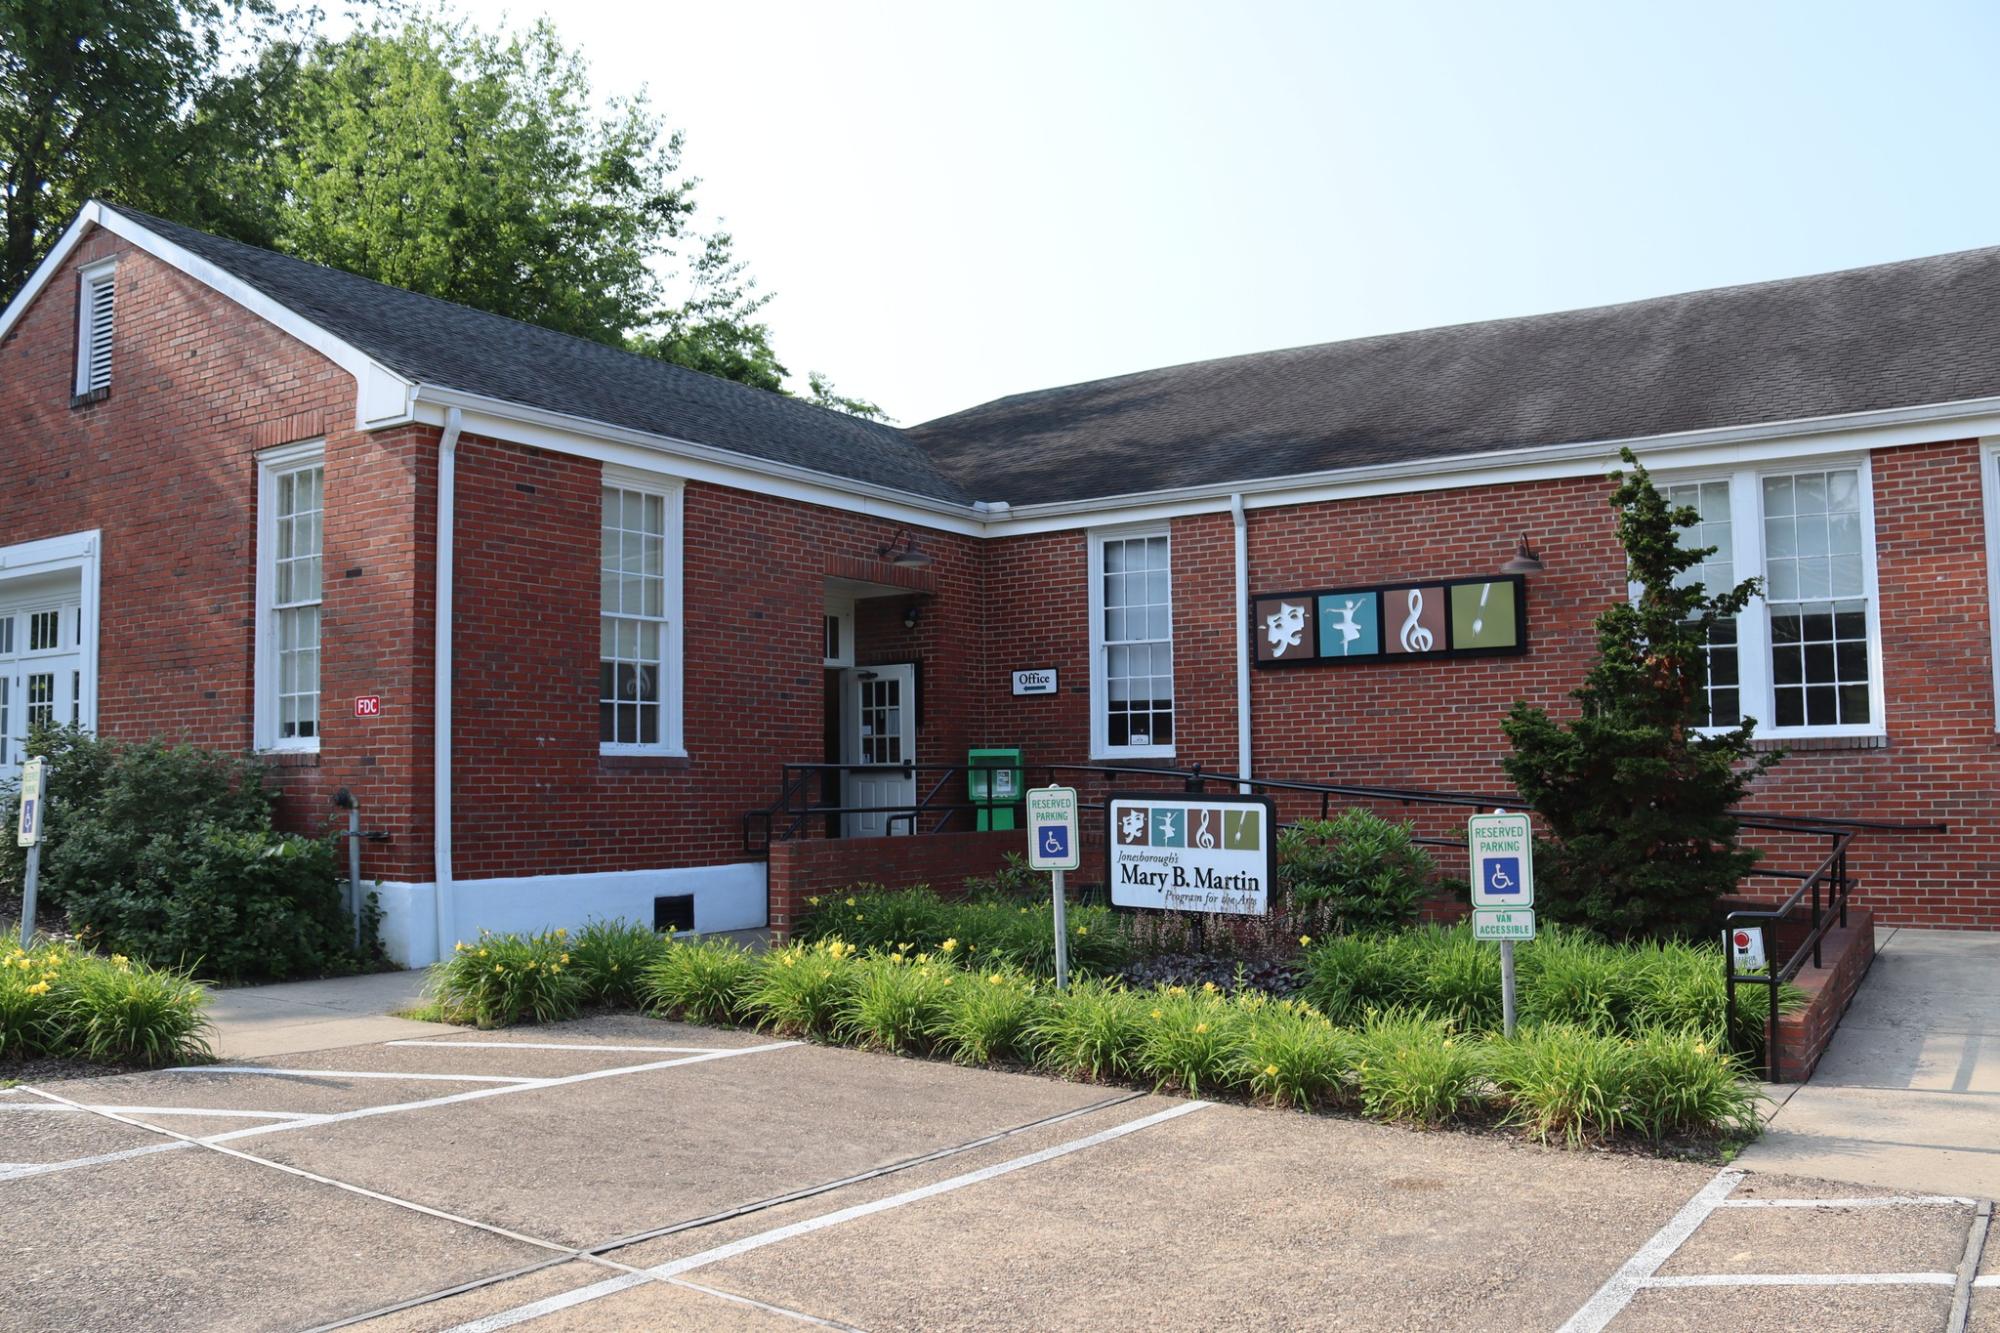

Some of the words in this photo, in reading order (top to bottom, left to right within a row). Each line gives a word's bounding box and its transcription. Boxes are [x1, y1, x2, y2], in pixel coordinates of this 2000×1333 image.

[1019, 672, 1050, 685] Office
[357, 698, 377, 714] FDC
[1031, 799, 1071, 809] RESERVED
[1036, 811, 1068, 821] PARKING
[1475, 826, 1524, 838] RESERVED
[1480, 841, 1520, 853] PARKING
[1117, 850, 1179, 867] Jonesborough's
[1120, 863, 1169, 892] Mary
[1172, 866, 1190, 888] B.
[1194, 867, 1260, 891] Martin
[1165, 889, 1202, 904] Program
[1203, 892, 1219, 906] for
[1496, 914, 1512, 923] VAN
[1480, 925, 1529, 935] ACCESSIBLE
